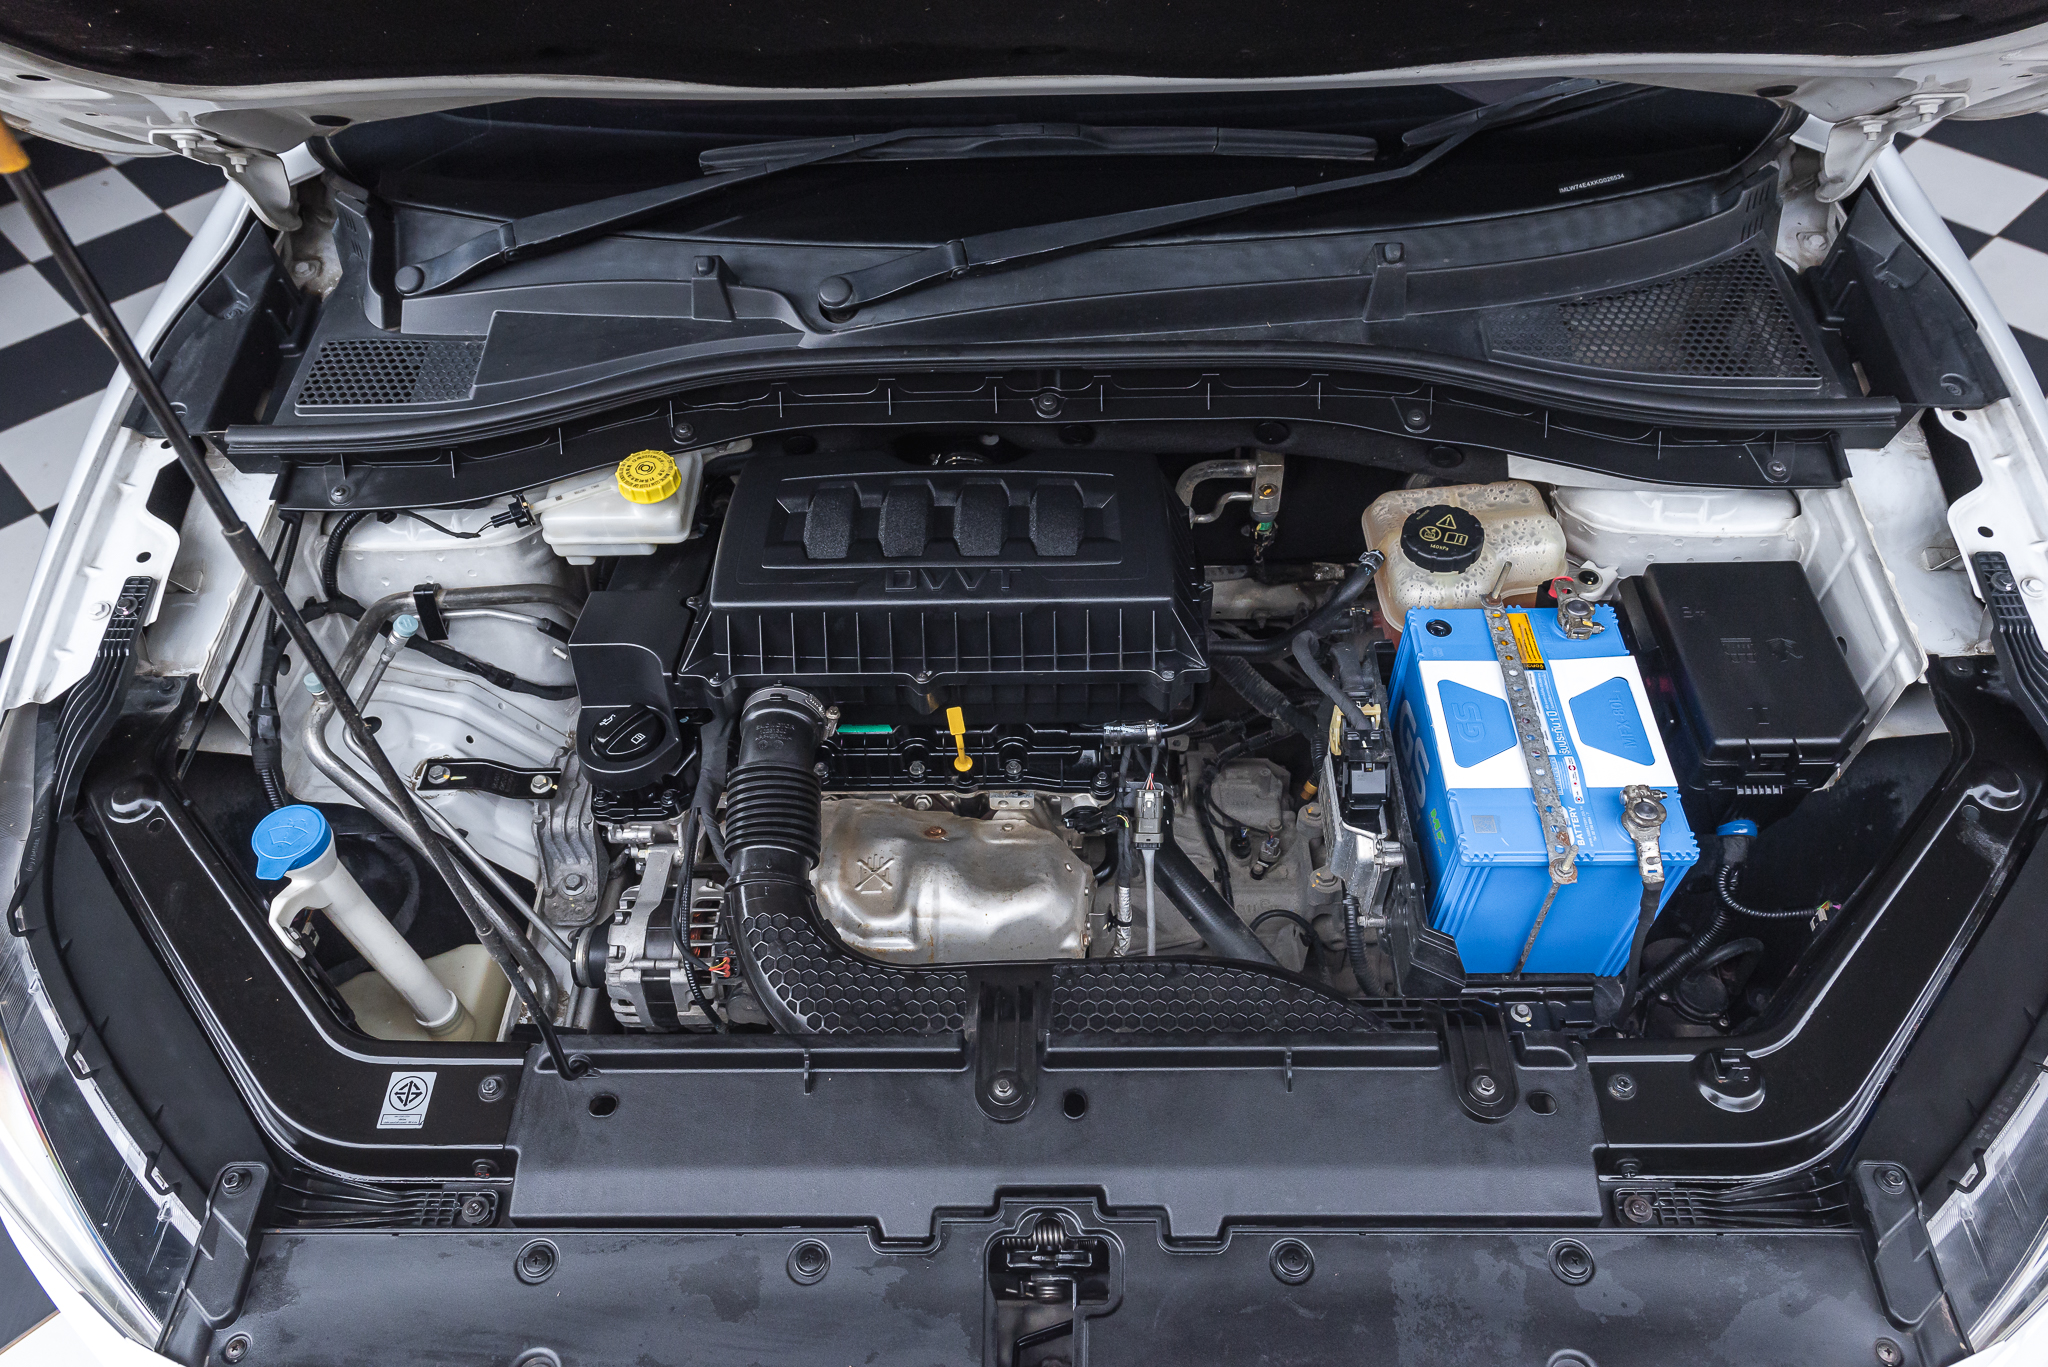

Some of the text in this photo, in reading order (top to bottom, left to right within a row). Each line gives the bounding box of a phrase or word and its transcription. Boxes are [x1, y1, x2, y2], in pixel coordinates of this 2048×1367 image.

[885, 568, 1022, 592] DVVT
[1452, 702, 1486, 742] GS
[1568, 806, 1586, 846] BATTERY
